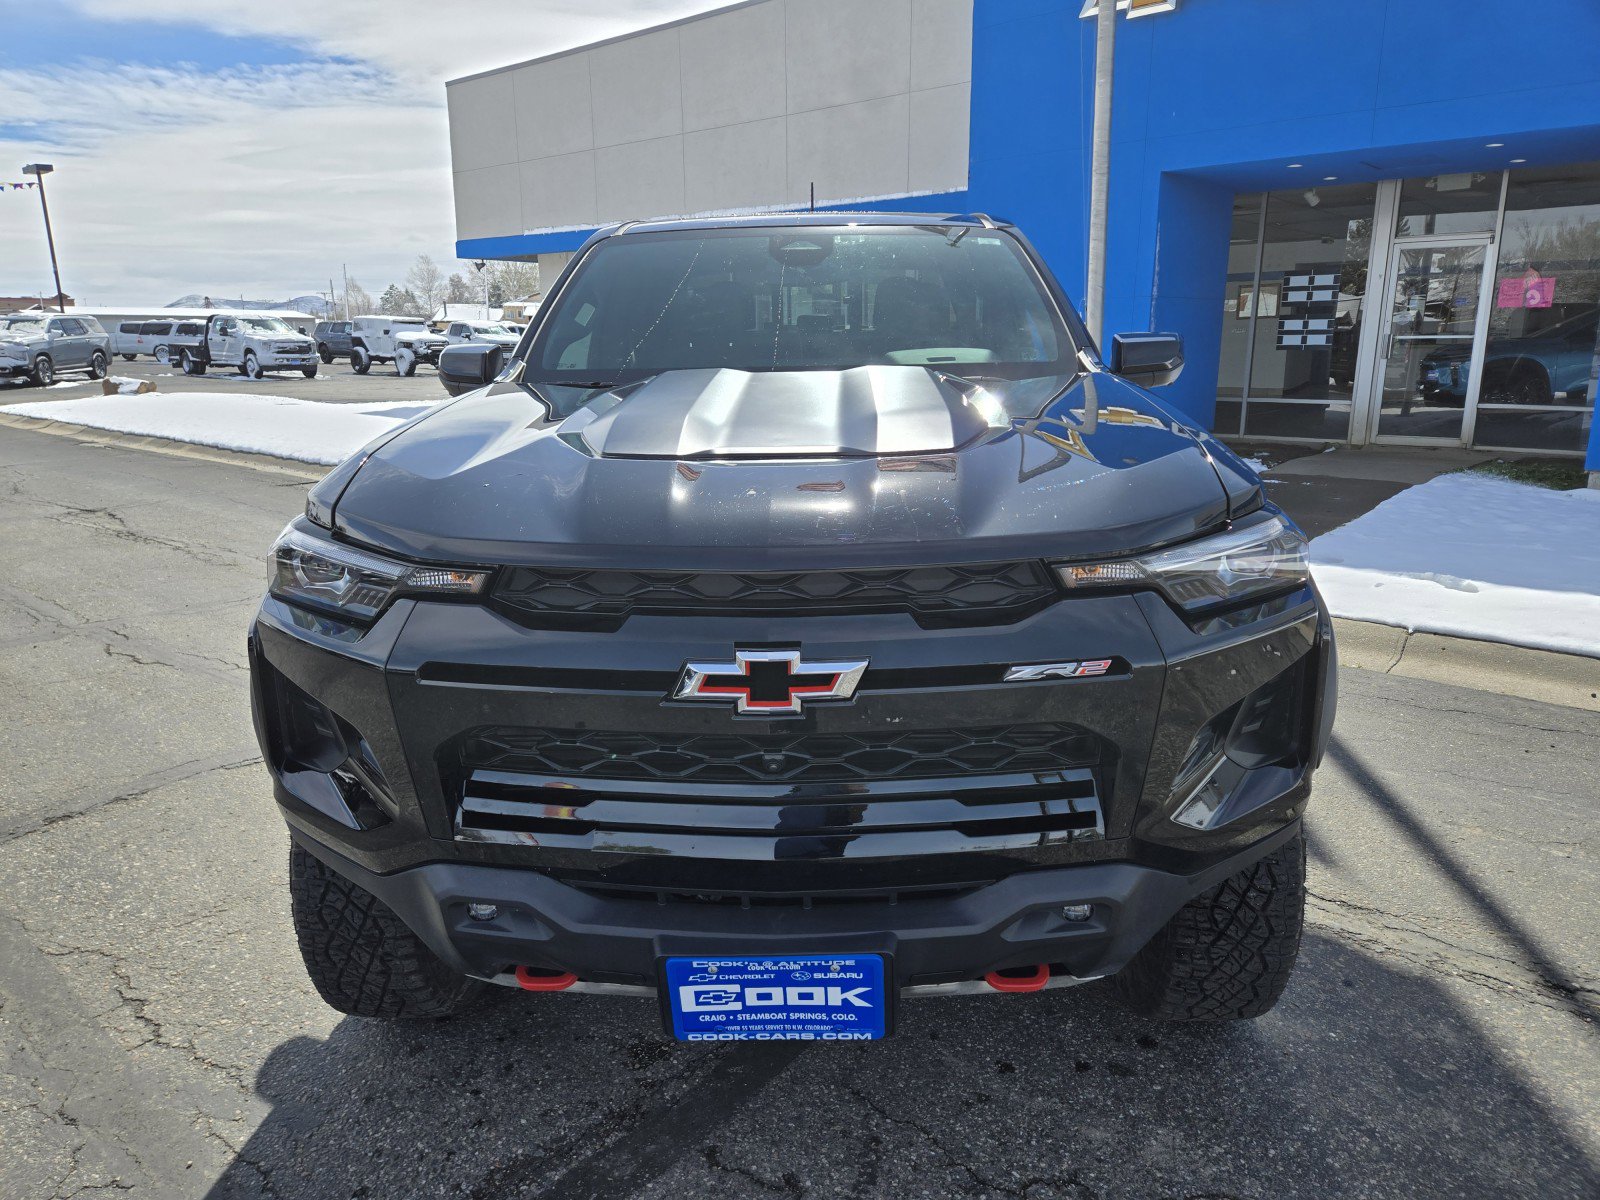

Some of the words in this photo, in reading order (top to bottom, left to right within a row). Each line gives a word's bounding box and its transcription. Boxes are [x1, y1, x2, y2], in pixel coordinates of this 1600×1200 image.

[1003, 660, 1112, 681] ZR2
[679, 984, 874, 1012] COOK
[699, 1014, 727, 1022] CRAIG
[737, 1012, 788, 1020] STEAMBOAT
[789, 1012, 829, 1021] SPRINGS,
[831, 1013, 858, 1021] COLO.
[687, 1032, 872, 1041] COOK-CARS.COM
